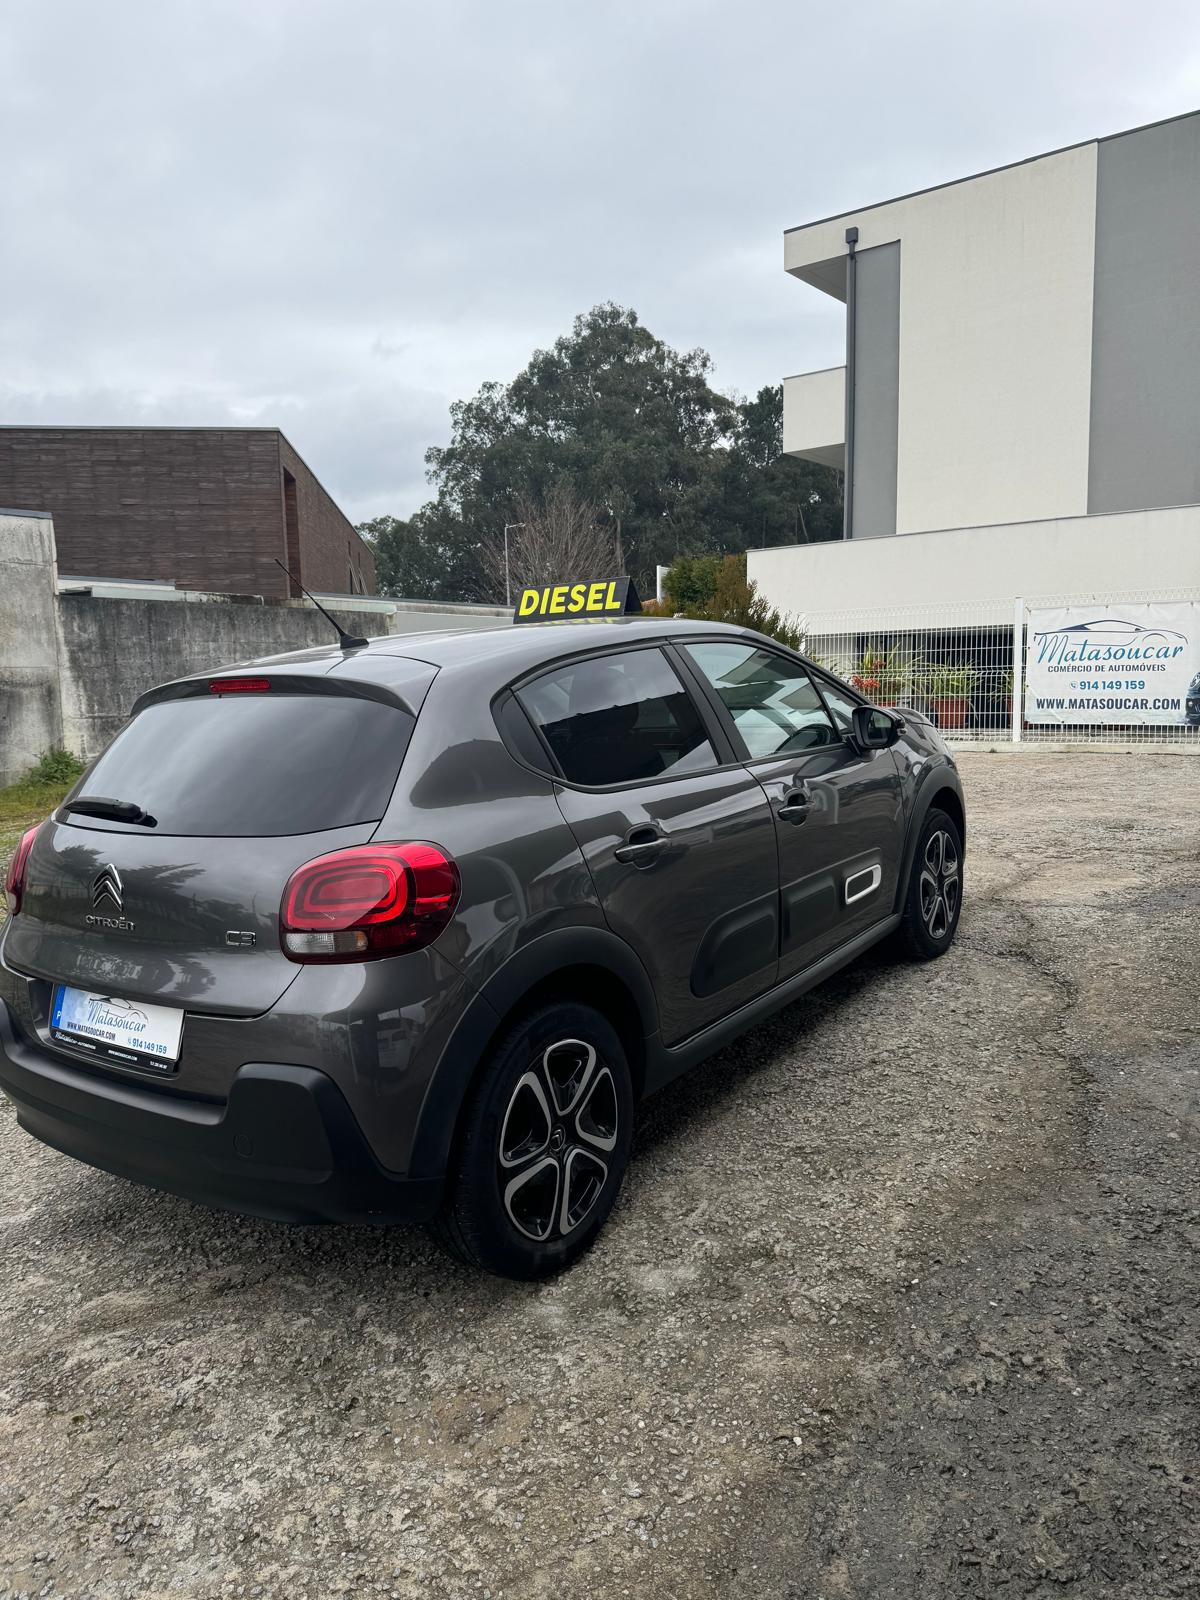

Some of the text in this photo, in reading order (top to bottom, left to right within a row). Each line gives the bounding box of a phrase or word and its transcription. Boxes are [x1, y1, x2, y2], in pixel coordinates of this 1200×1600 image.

[519, 581, 621, 616] DIESEL
[1037, 634, 1184, 665] Matasoucar
[1048, 663, 1166, 673] COMÉRCIO DE AUTOMÓVEIS
[1079, 680, 1145, 690] 914 149 159
[1036, 698, 1181, 710] WWW.MATASOUCAR.COM
[225, 930, 256, 946] C3
[87, 1001, 147, 1033] Matasoucar
[67, 1021, 116, 1041] WWW.MATASOUCAR.COM
[132, 1037, 168, 1055] 914 149 159
